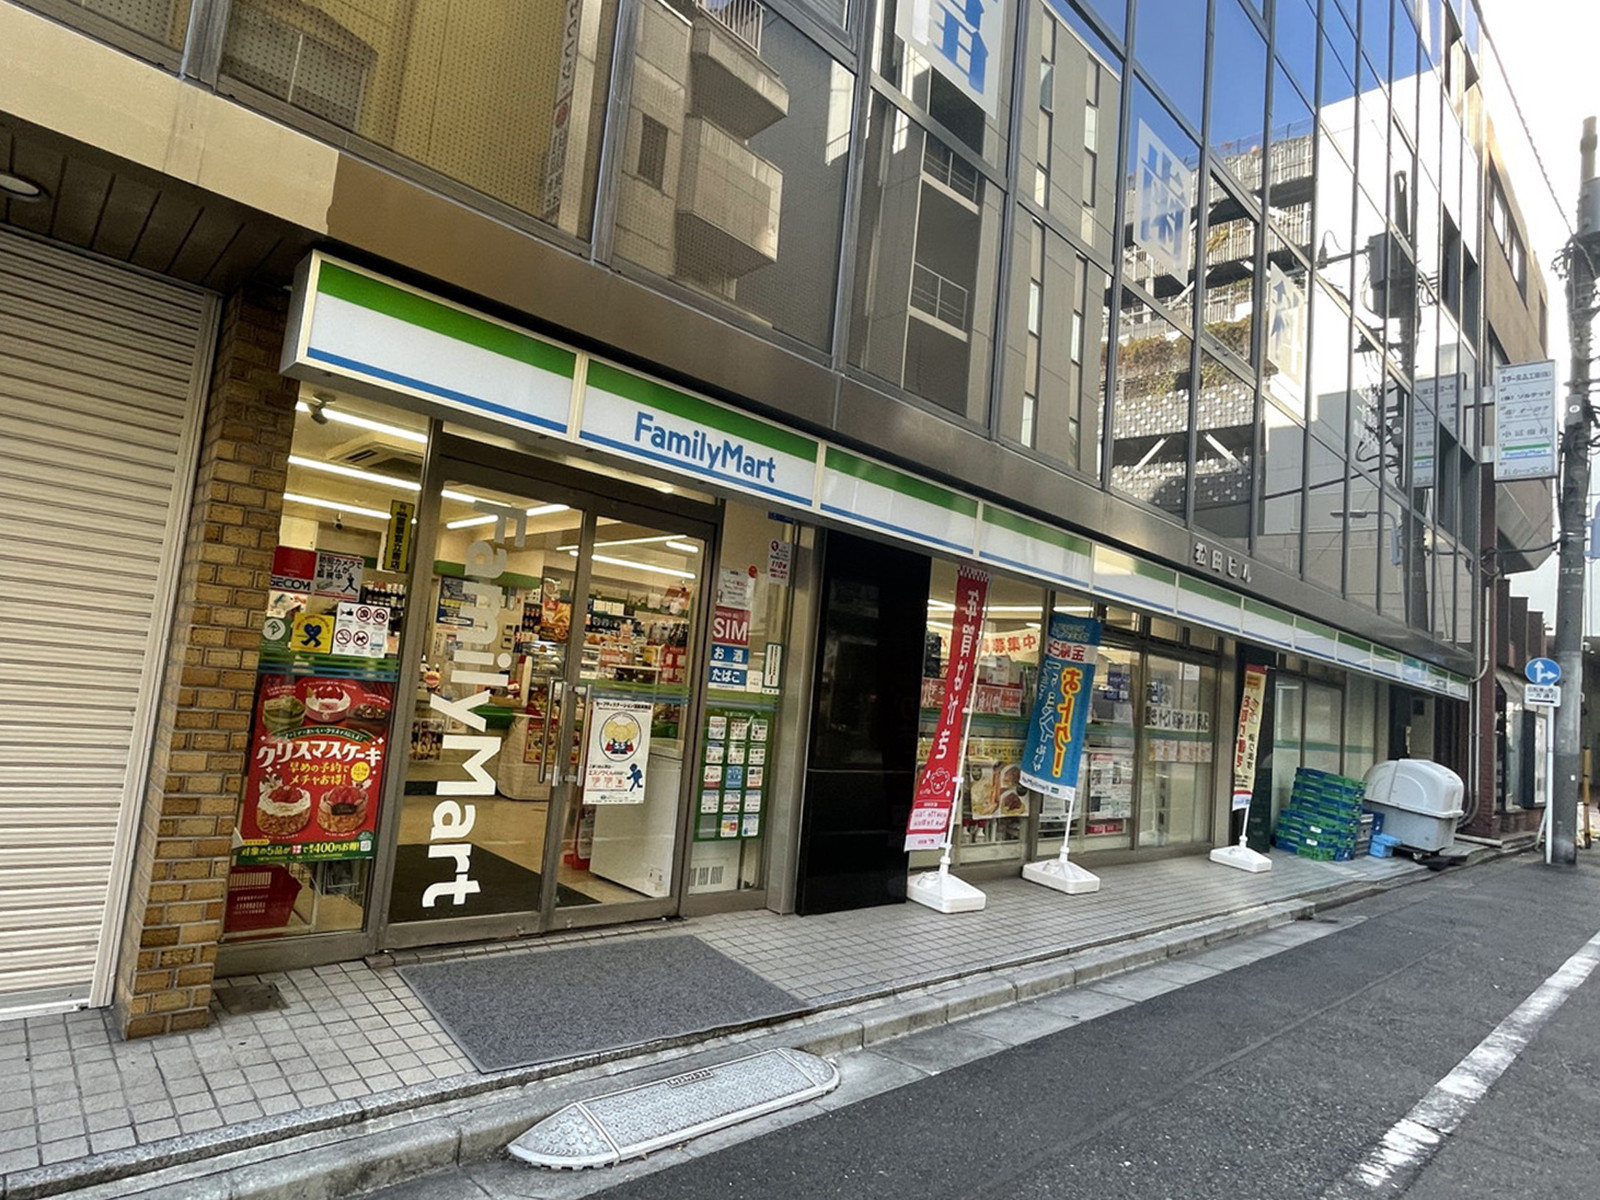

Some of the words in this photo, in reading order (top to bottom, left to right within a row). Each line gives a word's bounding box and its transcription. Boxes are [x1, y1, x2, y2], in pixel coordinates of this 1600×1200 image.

[634, 411, 776, 483] FamilyMart
[713, 618, 748, 641] SIM
[714, 646, 744, 662] お酒
[712, 668, 740, 683] たばこ
[422, 500, 527, 907] FamilyMart
[256, 740, 381, 768] クリスマスケーキ
[289, 761, 350, 774] 早めの予約で
[289, 774, 347, 786] メチャお得!
